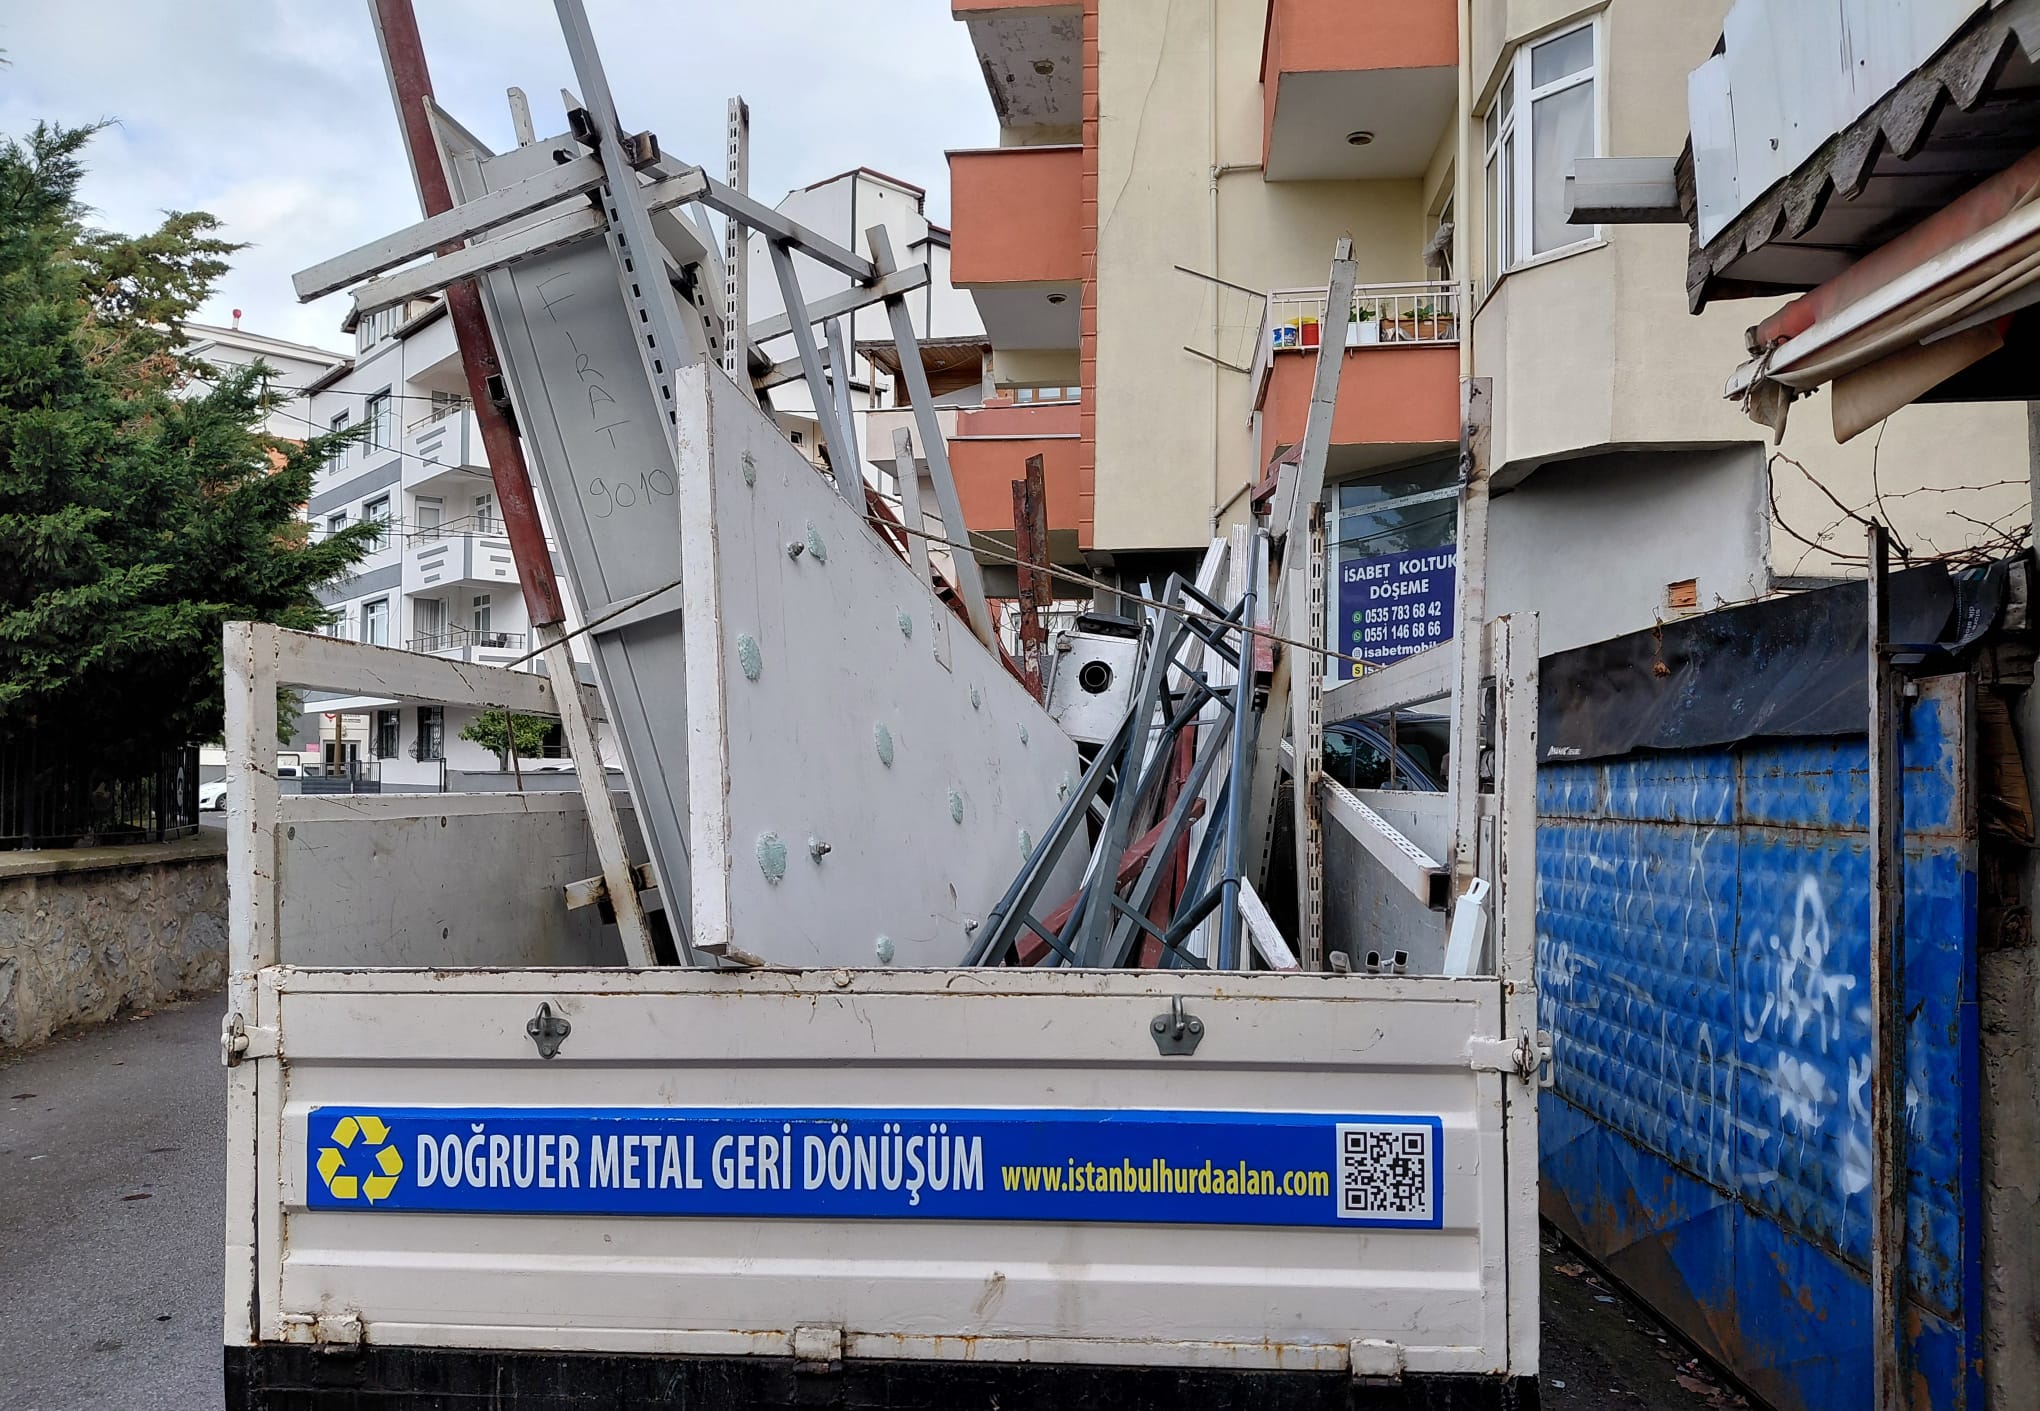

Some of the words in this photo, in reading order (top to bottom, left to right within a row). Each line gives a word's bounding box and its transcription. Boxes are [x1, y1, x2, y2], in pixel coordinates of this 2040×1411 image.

[589, 468, 675, 519] 9010
[1344, 564, 1391, 583] İSABET
[1399, 553, 1457, 575] KOLTUK
[1370, 578, 1429, 600] DÖŞEME
[1365, 607, 1389, 623] 0535
[1391, 604, 1410, 621] 783
[1412, 602, 1426, 619] 68
[1427, 600, 1441, 616] 42
[1364, 623, 1388, 642] 0551
[1391, 624, 1410, 640] 146
[1412, 622, 1425, 638] 68
[1427, 620, 1441, 636] 66
[416, 1123, 580, 1189] DOĞRUER
[590, 1134, 703, 1190] METAL
[711, 1123, 792, 1190] GERİ
[803, 1123, 985, 1206] DÖNÜŞÜM
[1002, 1157, 1330, 1197] www.istanbulhurdaalan.com
